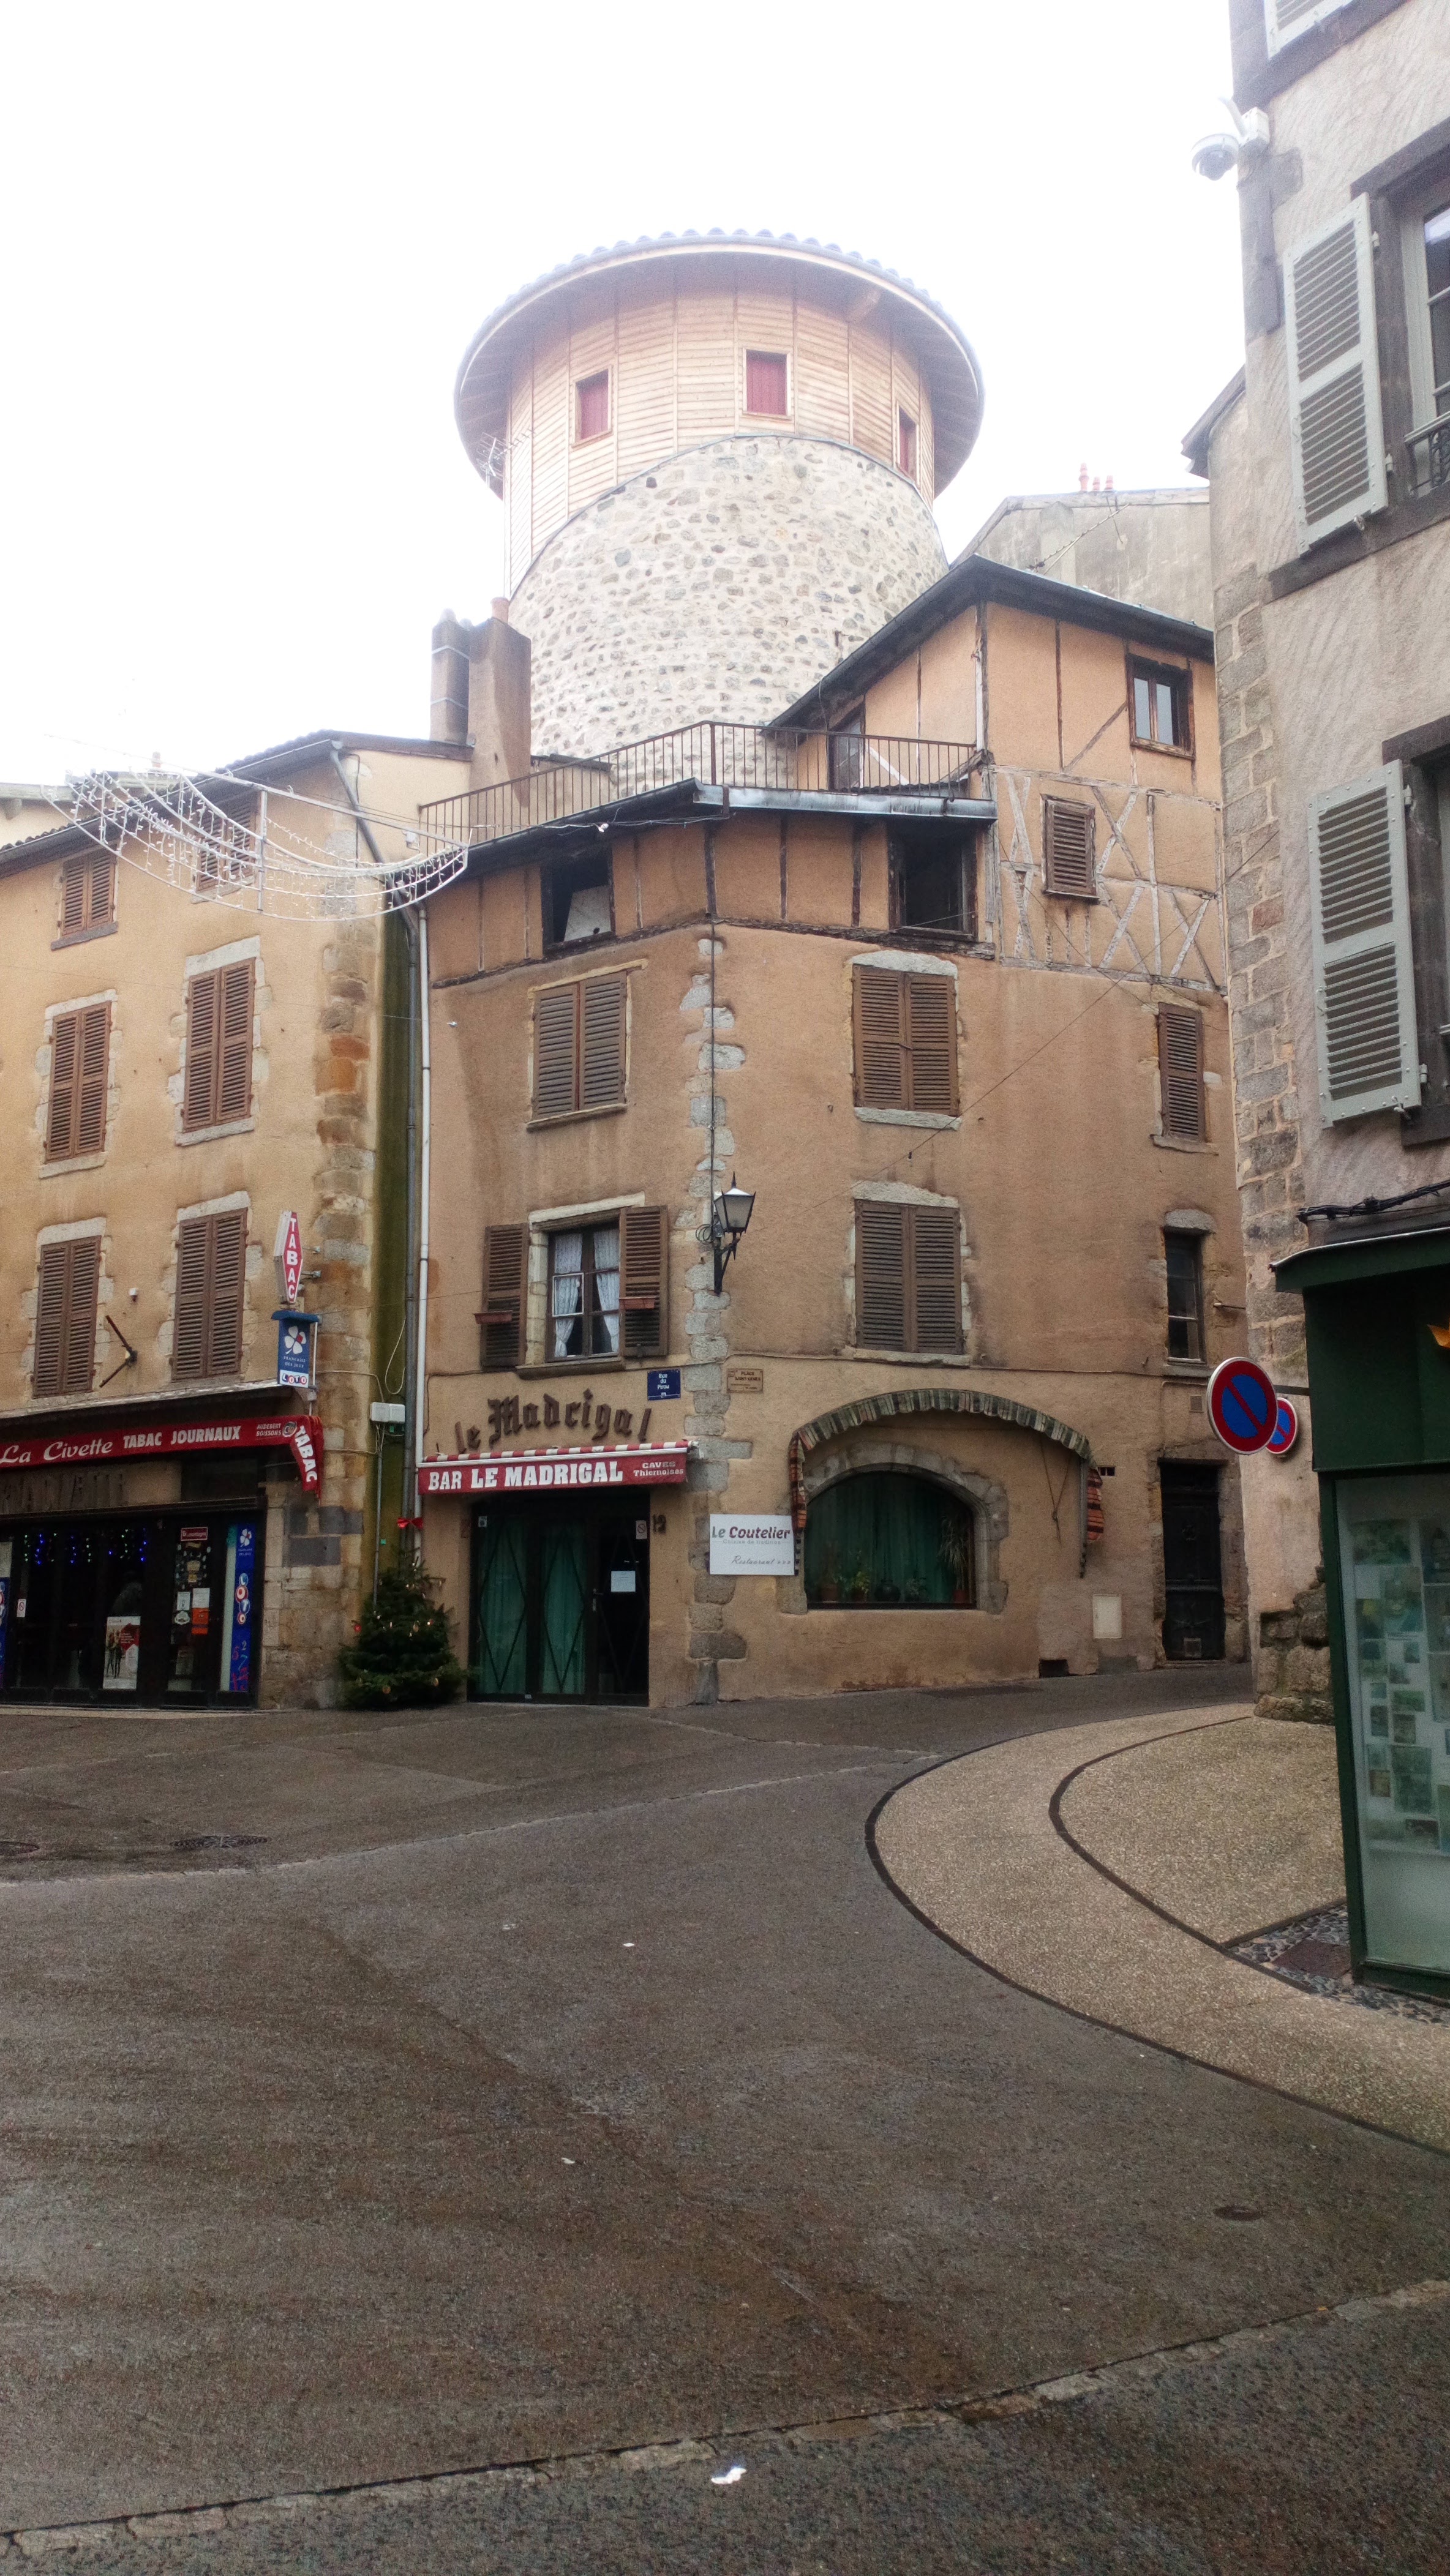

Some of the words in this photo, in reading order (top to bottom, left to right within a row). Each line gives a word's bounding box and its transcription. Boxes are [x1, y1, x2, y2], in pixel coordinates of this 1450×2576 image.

[287, 1218, 298, 1299] TABAC
[282, 1373, 307, 1385] LOTO
[487, 1388, 652, 1449] Madrigal
[0, 1445, 31, 1464] La
[43, 1439, 113, 1461] Civette
[123, 1432, 163, 1449] TABAC
[171, 1426, 241, 1445] JOURNAUX
[295, 1425, 318, 1483] TABAC
[428, 1471, 462, 1491] BAR
[470, 1467, 498, 1489] LE
[504, 1461, 623, 1487] MADRIGAL
[712, 1526, 726, 1538] Le
[729, 1526, 791, 1539] Coutelier
